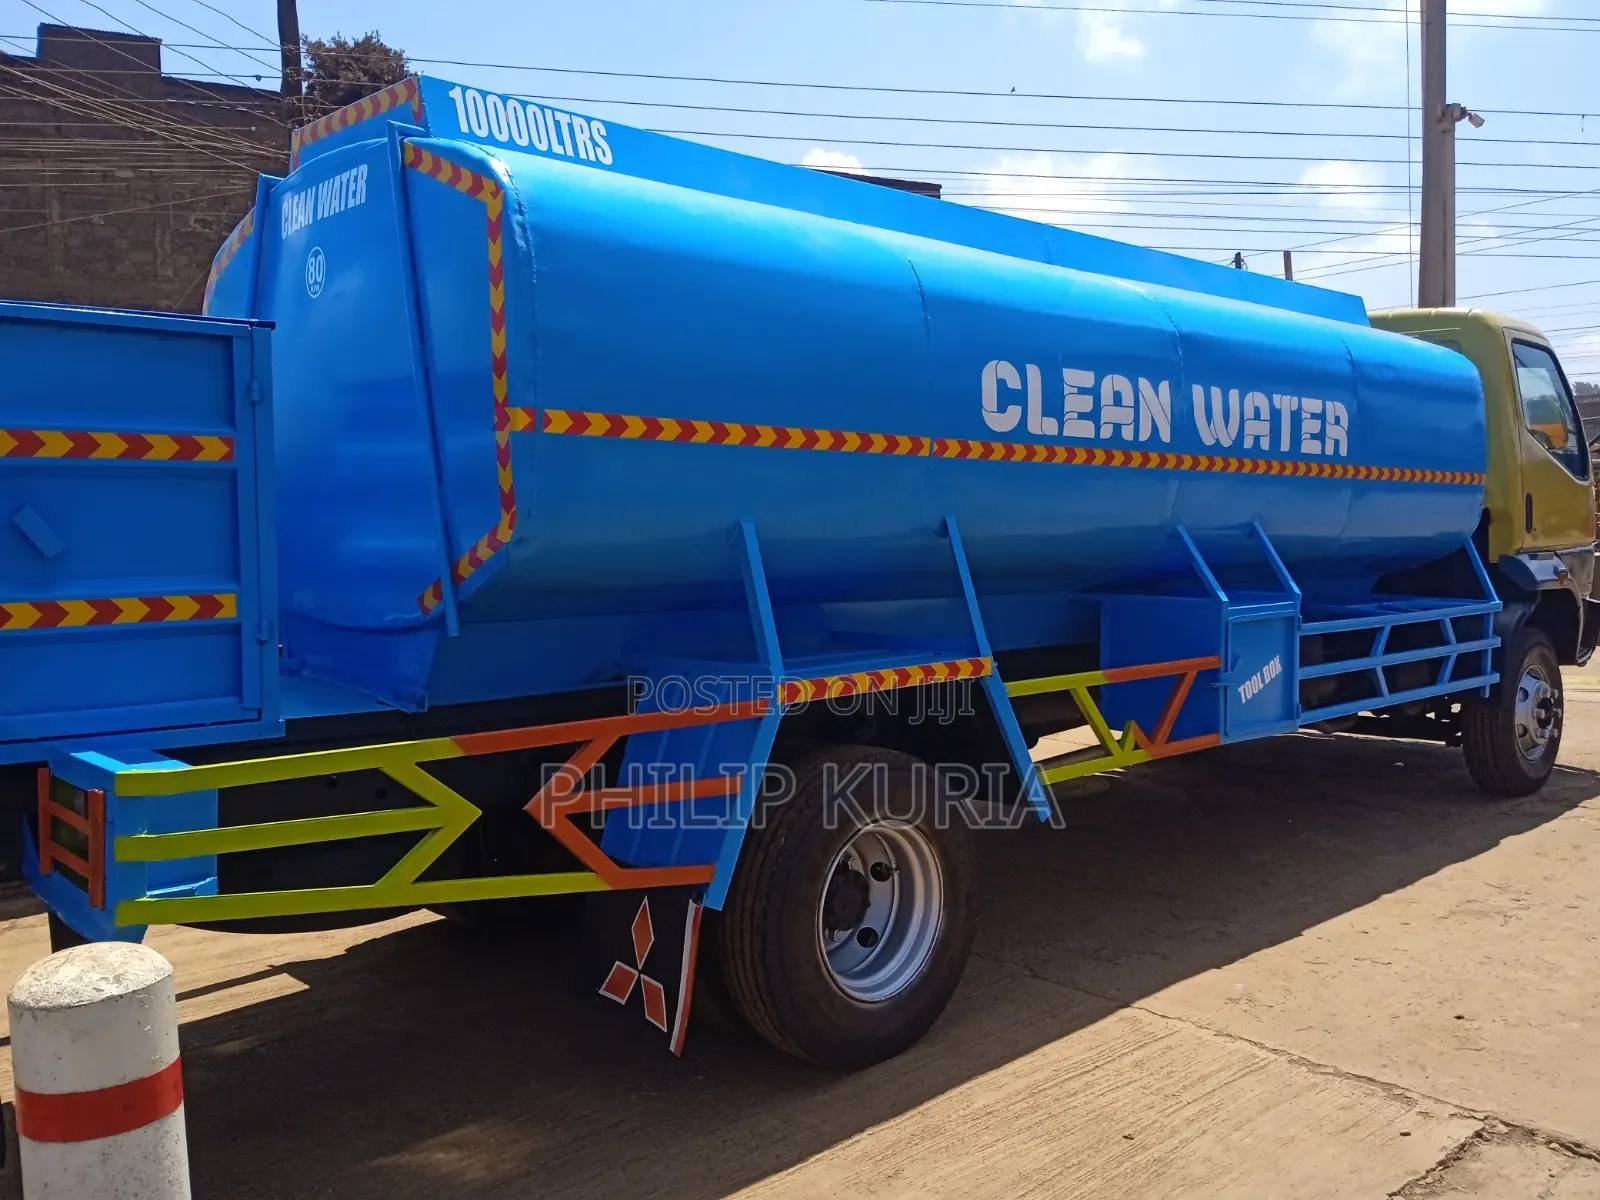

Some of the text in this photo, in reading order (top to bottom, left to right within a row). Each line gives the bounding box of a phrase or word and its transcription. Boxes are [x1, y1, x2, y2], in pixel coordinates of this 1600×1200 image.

[449, 86, 613, 166] 10000LTRS
[282, 164, 368, 240] CLEAN WATER
[308, 255, 323, 284] 80
[981, 359, 1348, 457] CLEAN WATER
[1238, 654, 1282, 704] TOOL BOX
